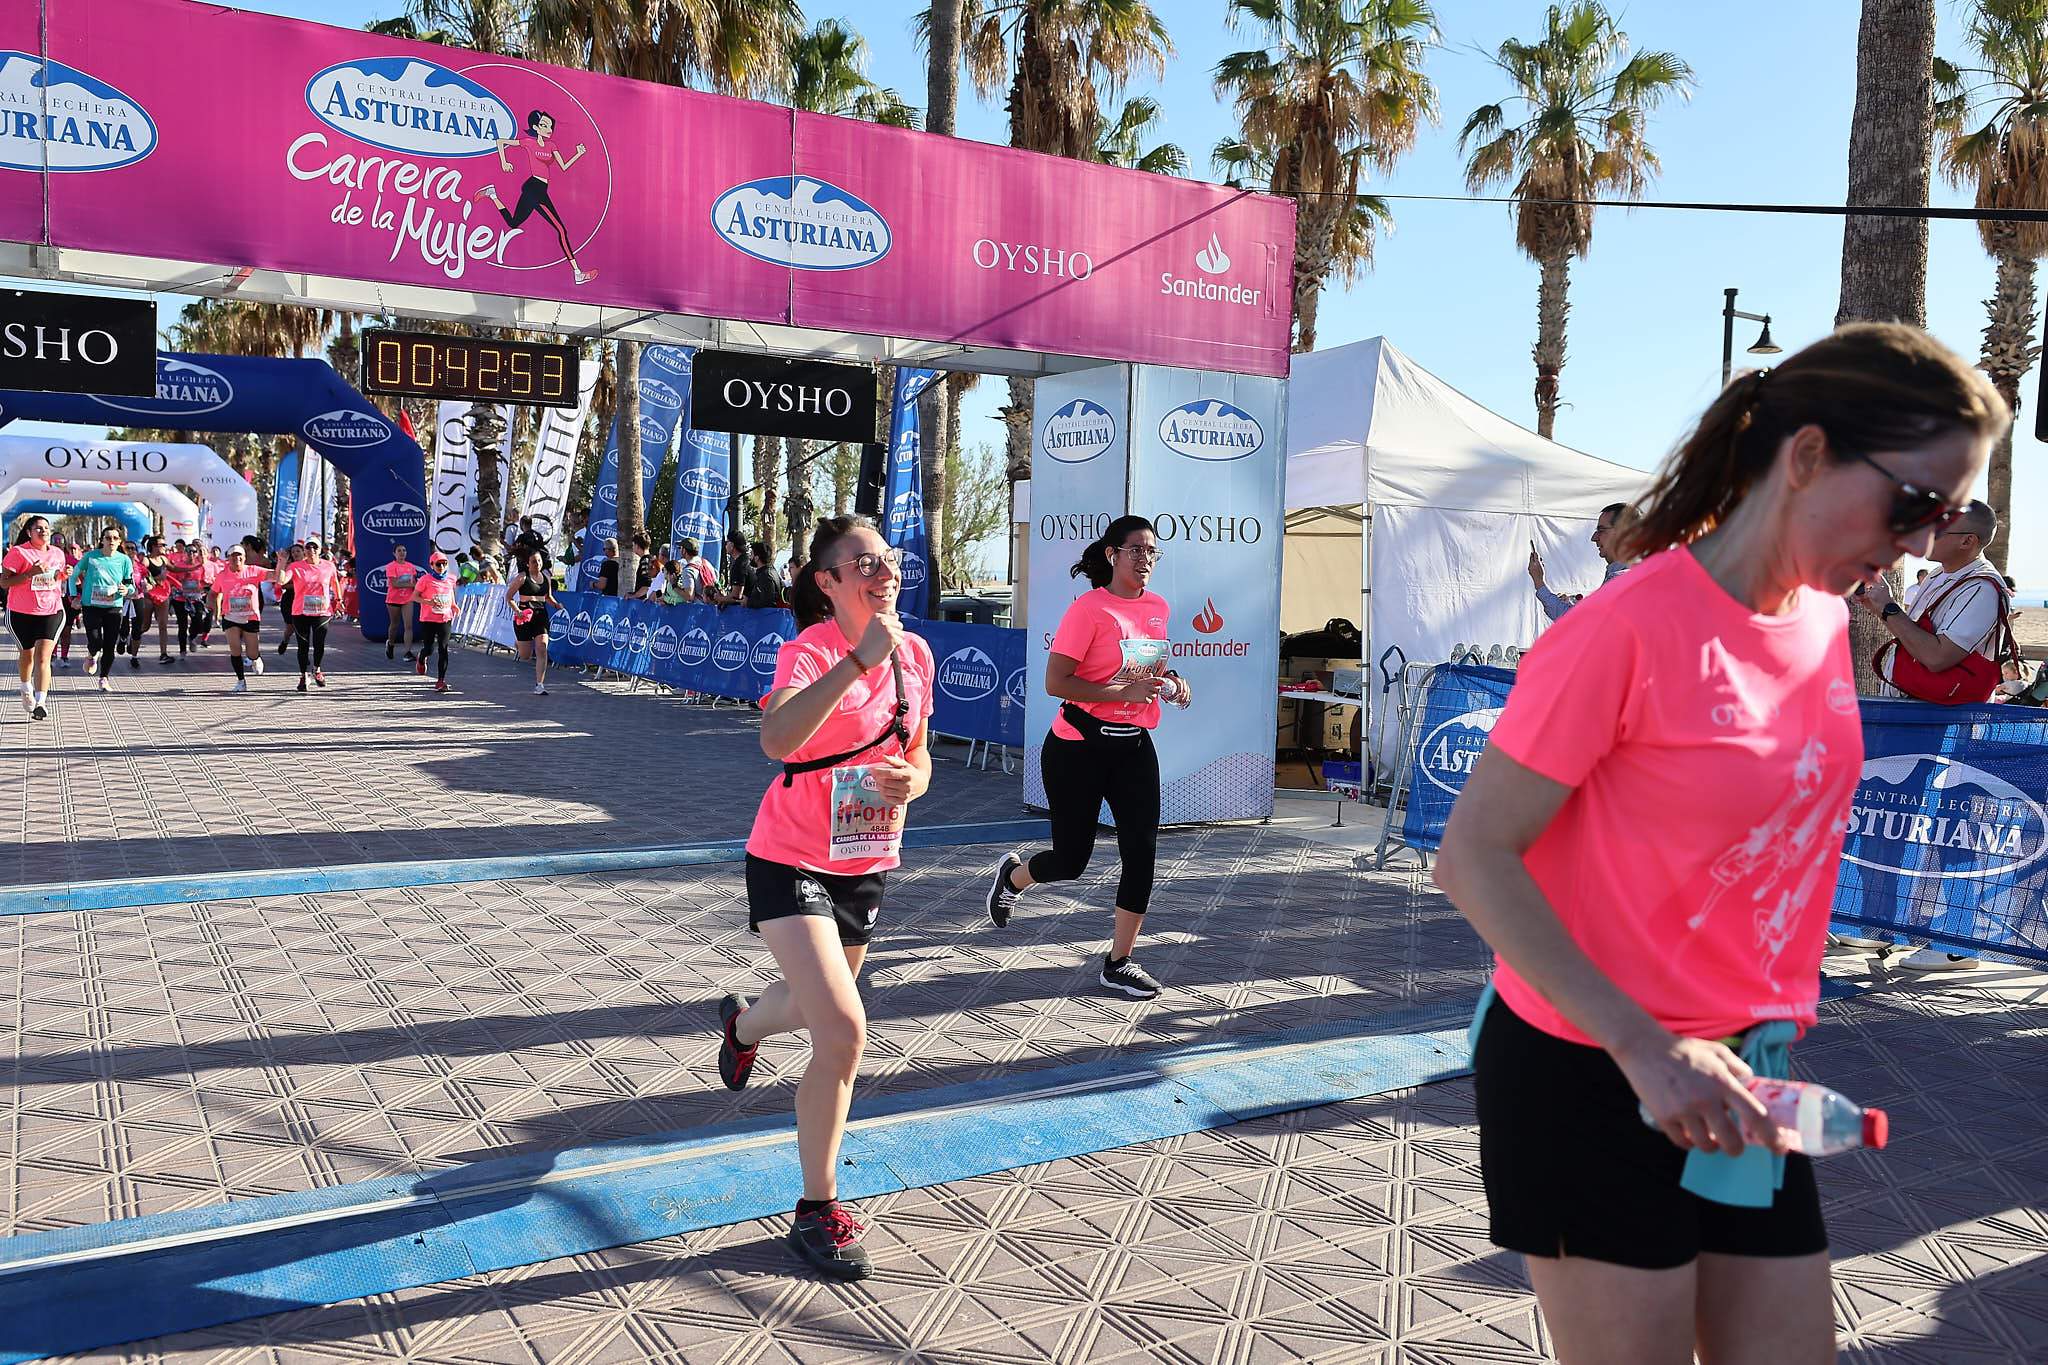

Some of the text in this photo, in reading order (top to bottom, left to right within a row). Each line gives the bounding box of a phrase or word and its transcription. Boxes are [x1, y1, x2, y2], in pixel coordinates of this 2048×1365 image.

[322, 80, 501, 141] ASTURIANA
[357, 82, 496, 114] CENTRAL LECHERA
[286, 132, 465, 203] Carrera
[725, 200, 879, 253] ASTURIANA
[755, 202, 873, 227] CENTRAL LECHERA
[330, 190, 525, 279] de la Mujer
[972, 238, 1094, 281] OYSHO
[1160, 272, 1262, 306] Santander
[378, 341, 564, 396] 00:42:53
[723, 378, 852, 417] OYSHO
[311, 423, 387, 439] ASTURIANA
[1046, 425, 1110, 449] ASTURIANA
[1165, 418, 1256, 448] ASTURIANA
[45, 446, 168, 473] OYSHO
[201, 476, 237, 485] OYSHO
[366, 513, 424, 528] ASTURIANA
[1041, 512, 1112, 542] OYSHO
[1154, 513, 1262, 544] OYSHO
[1167, 638, 1251, 658] antander
[941, 663, 991, 690] ASTURIANA
[1852, 788, 1928, 808] CENTRAL
